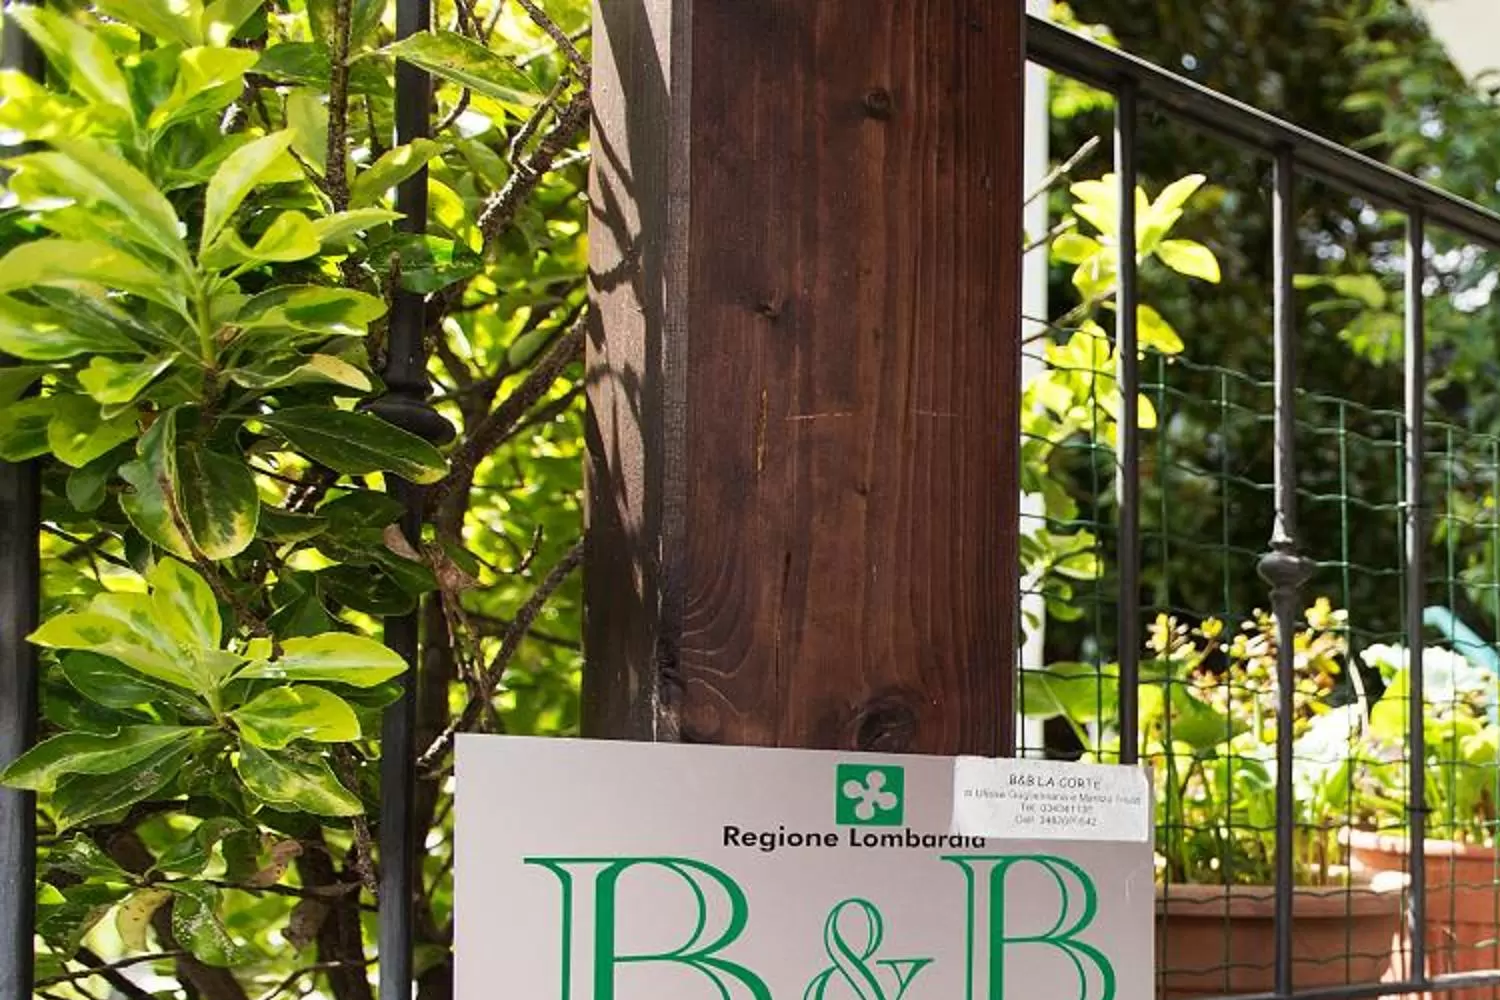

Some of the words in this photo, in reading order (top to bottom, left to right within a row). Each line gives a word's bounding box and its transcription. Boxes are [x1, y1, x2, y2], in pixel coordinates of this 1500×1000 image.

[1009, 774, 1034, 787] B&B
[1037, 776, 1055, 788] LA
[1059, 776, 1101, 790] CORTE
[723, 825, 839, 852] Regione
[849, 828, 986, 849] Lombardia
